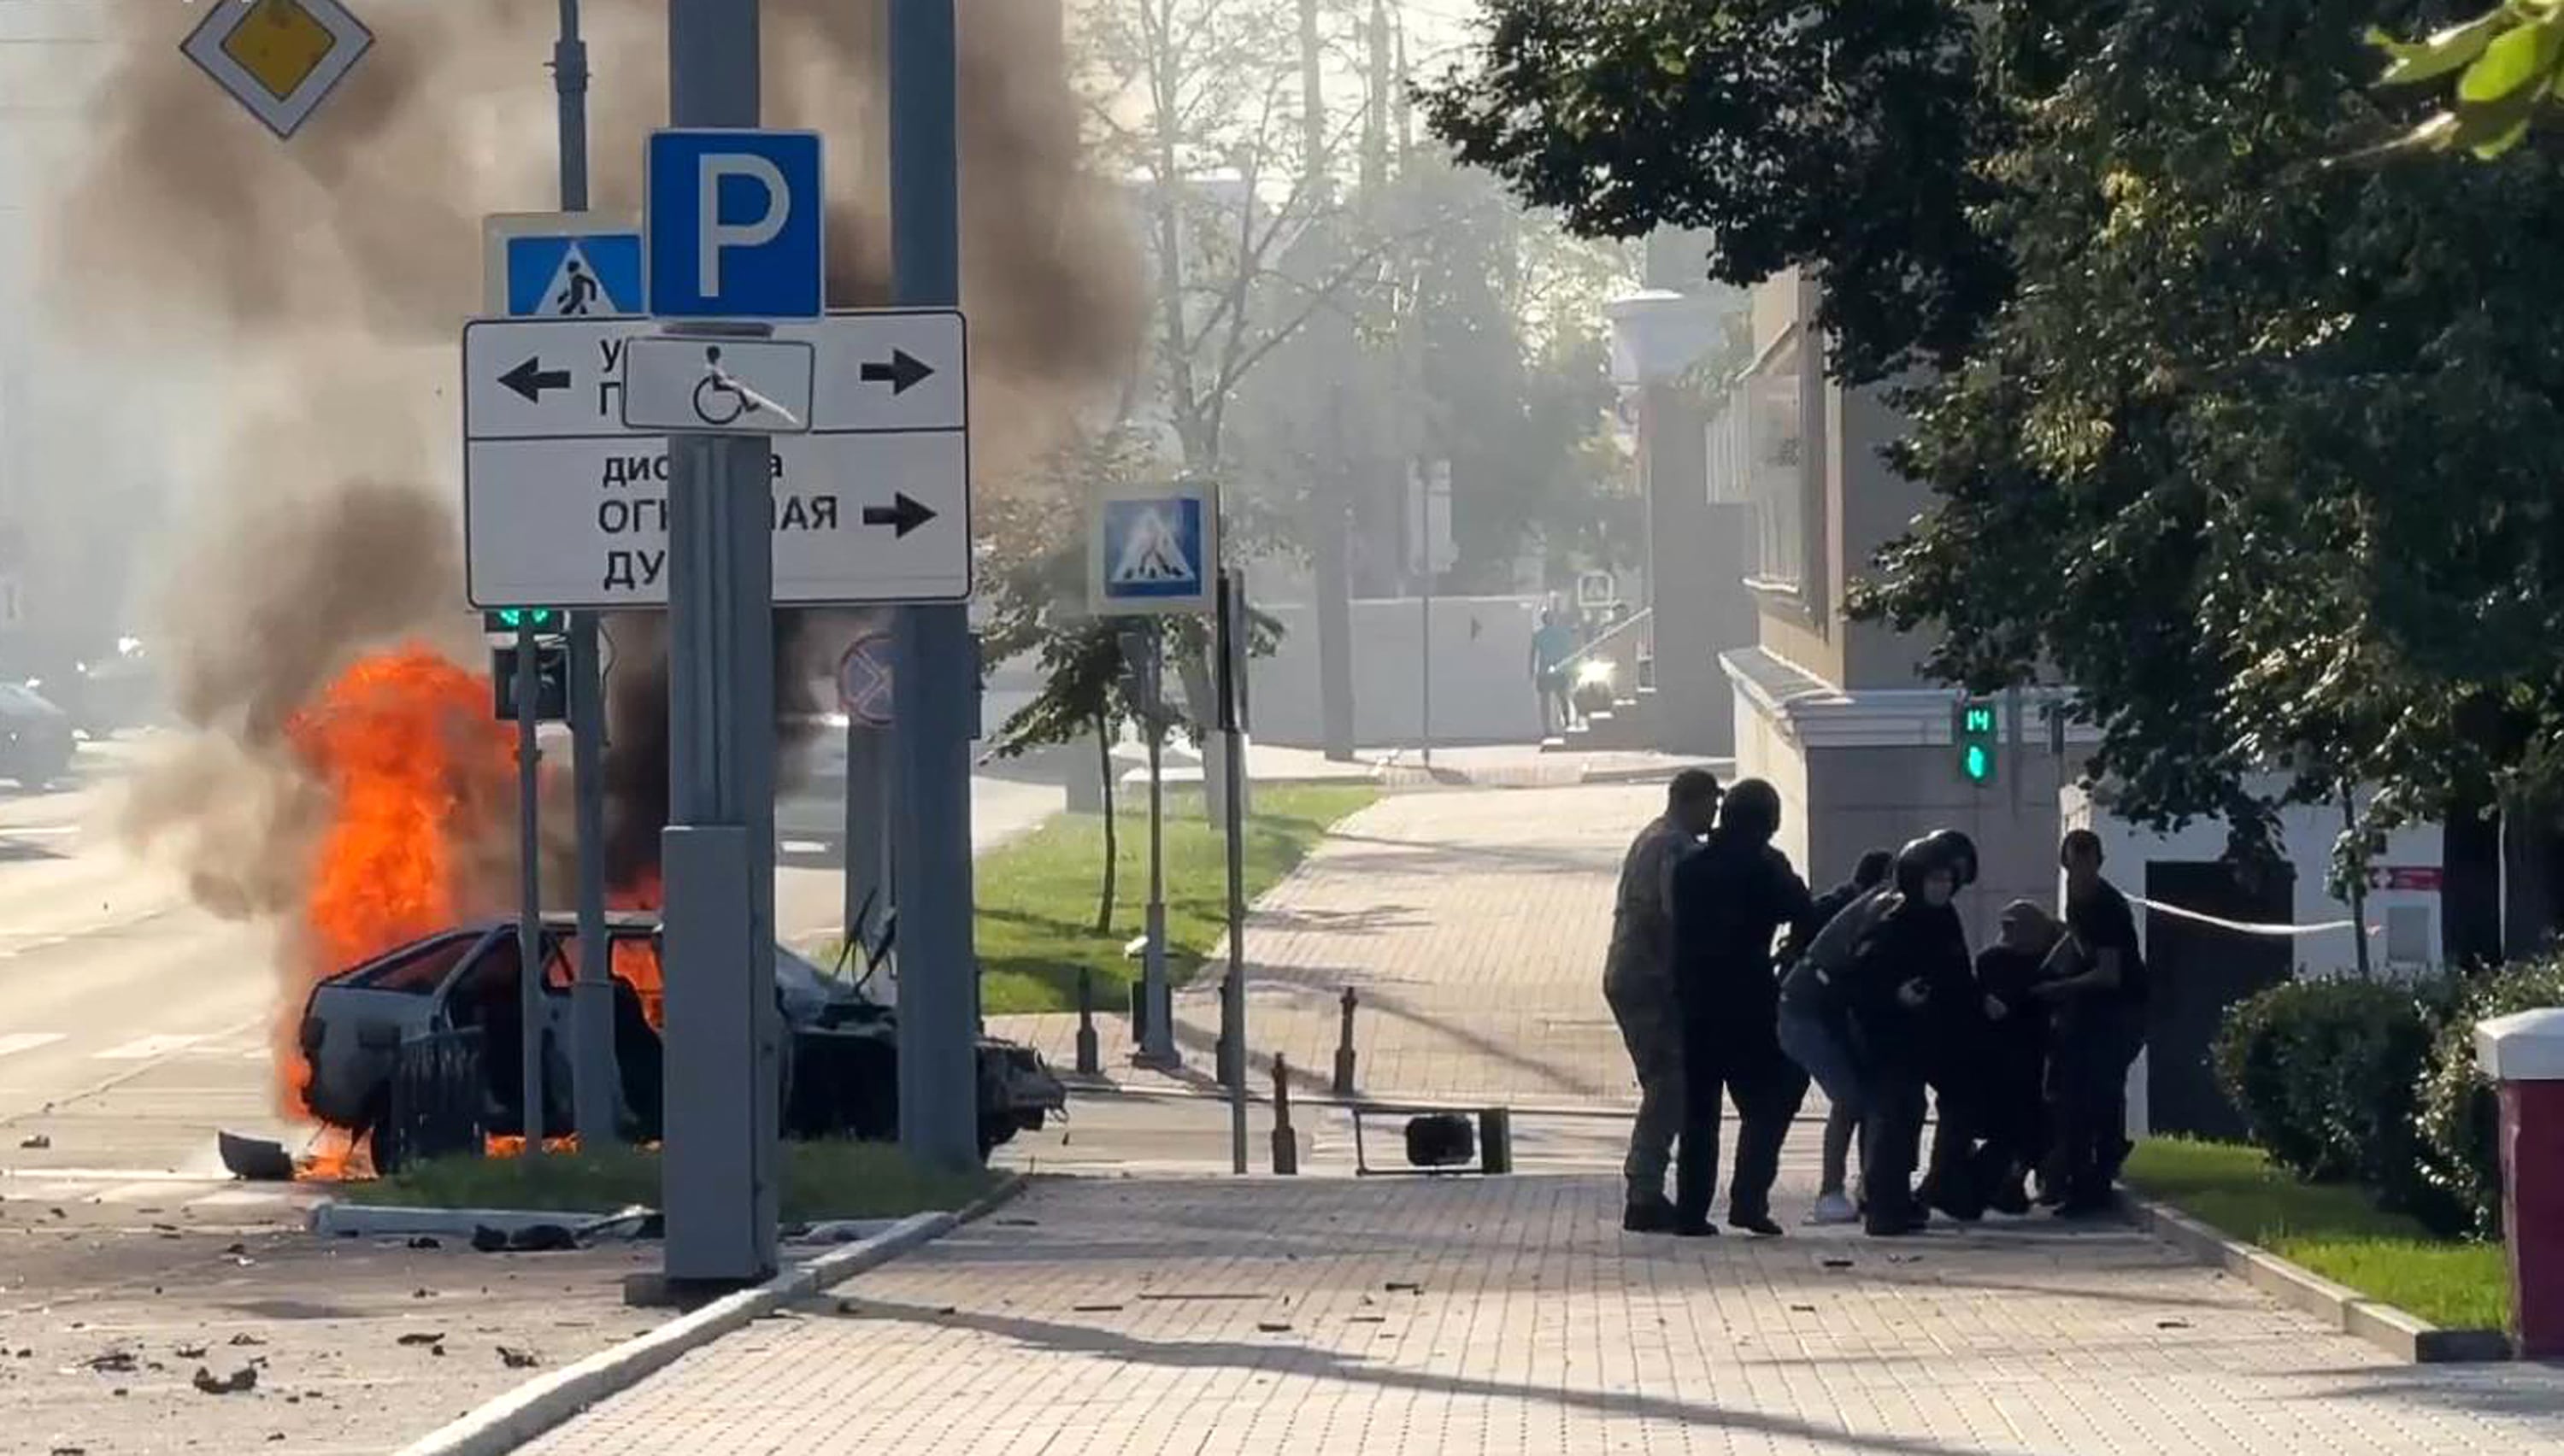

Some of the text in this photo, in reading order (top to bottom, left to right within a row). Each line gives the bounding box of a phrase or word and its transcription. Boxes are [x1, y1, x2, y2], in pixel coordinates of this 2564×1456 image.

[698, 154, 791, 297] P
[603, 549, 666, 590] ДУ
[1967, 710, 1990, 731] 14
